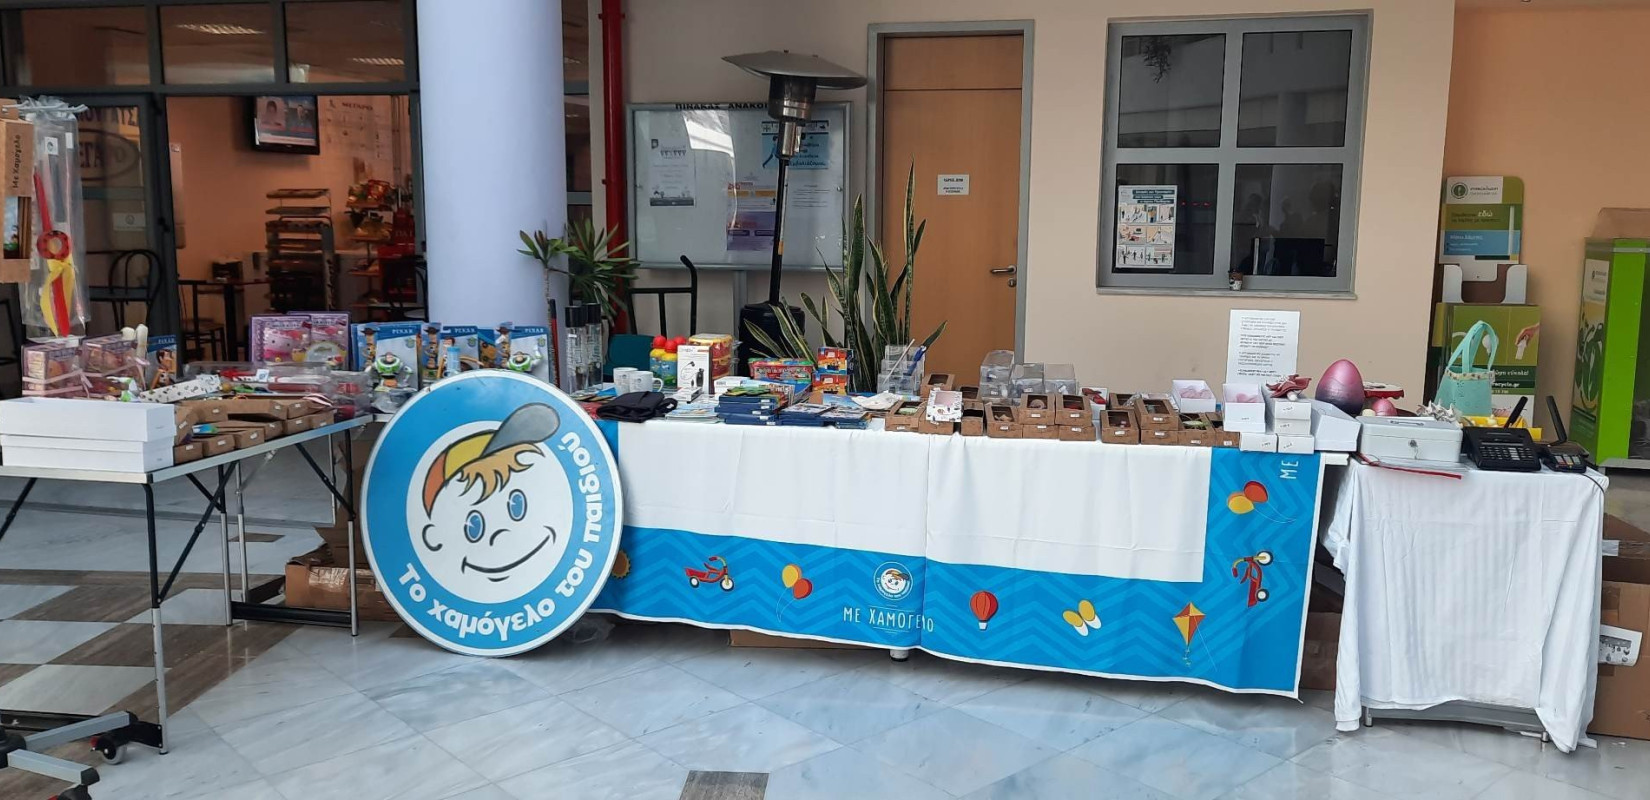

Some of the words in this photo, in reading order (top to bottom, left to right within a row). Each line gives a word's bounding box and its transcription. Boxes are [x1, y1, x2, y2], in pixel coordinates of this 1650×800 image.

[557, 431, 603, 544] παιδιού
[1279, 460, 1299, 479] ΜΕ
[399, 563, 426, 603] Το
[555, 548, 593, 598] του
[428, 597, 556, 642] χαμόγελο
[843, 606, 861, 623] ΜΕ
